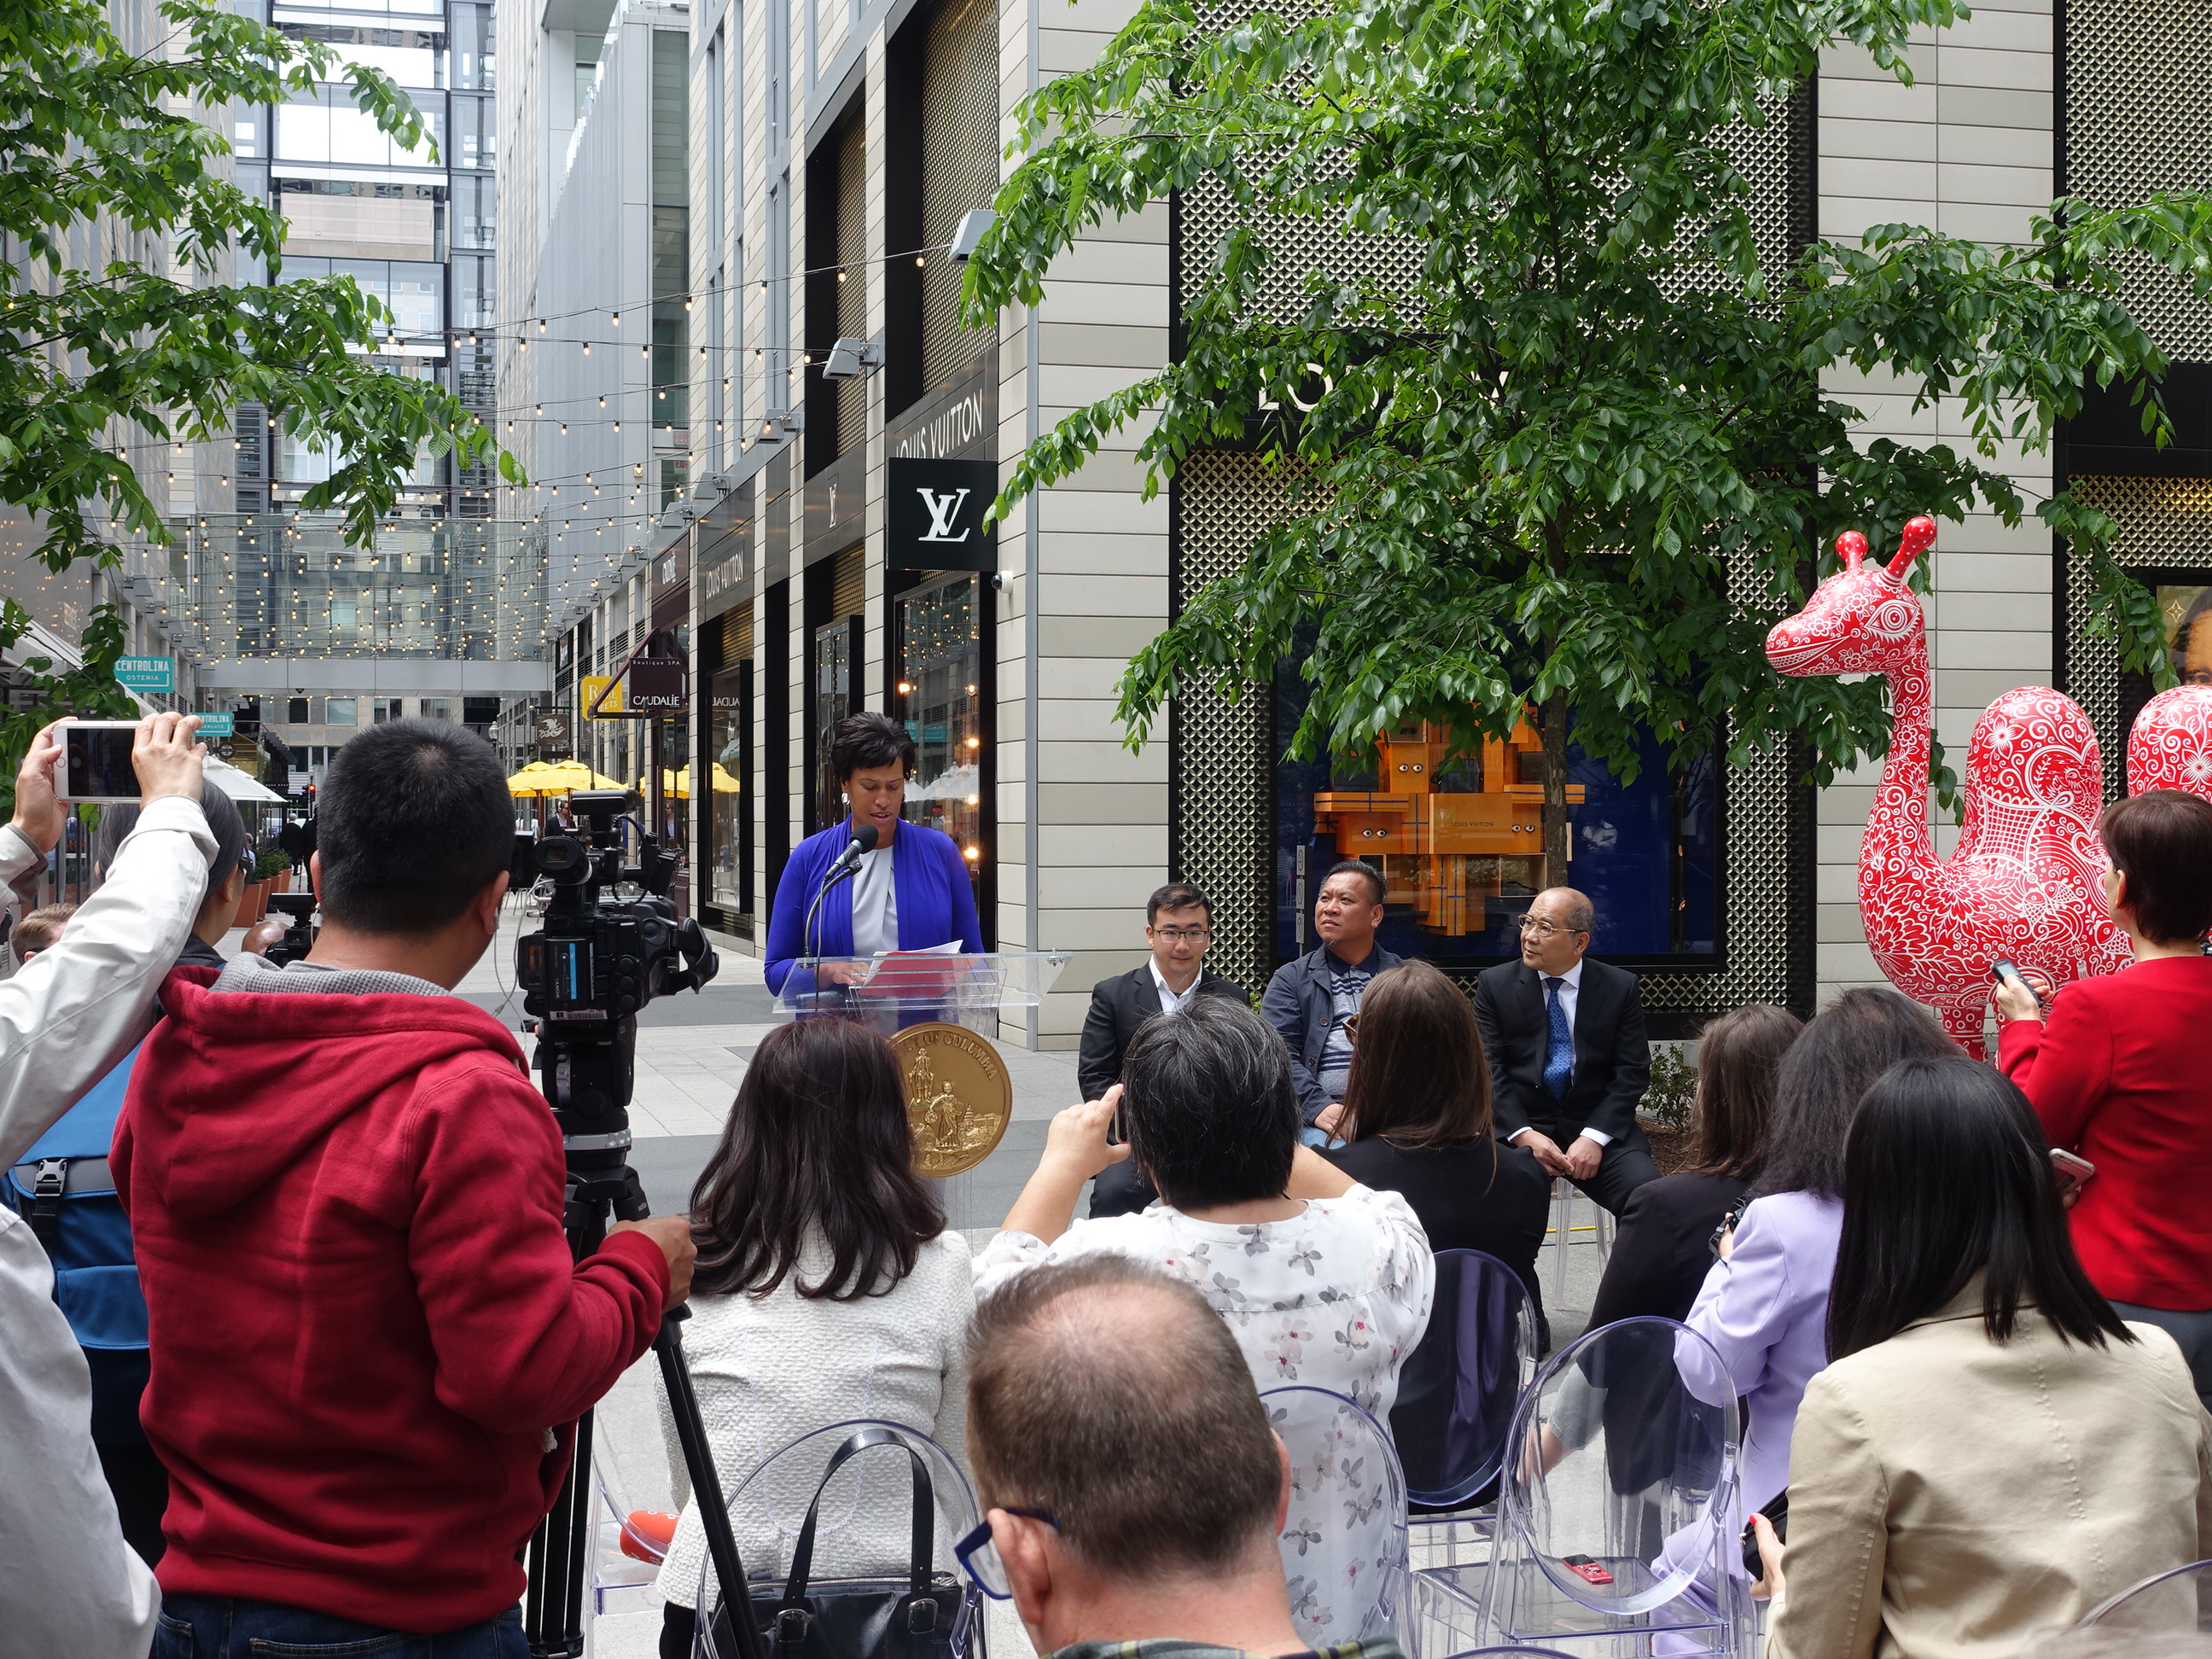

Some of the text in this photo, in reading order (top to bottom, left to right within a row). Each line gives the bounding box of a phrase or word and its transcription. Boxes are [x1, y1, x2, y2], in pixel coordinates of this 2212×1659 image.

[930, 387, 982, 459] VUITTON
[916, 487, 971, 543] LV
[706, 565, 720, 600] LOUIS
[721, 550, 744, 589] VUITTON
[115, 660, 170, 672] CENTROLINA
[588, 684, 618, 701] RE
[198, 714, 230, 723] NTROLINA
[527, 745, 536, 755] P
[923, 1030, 940, 1045] OF
[942, 1032, 999, 1082] COLUMBIA
